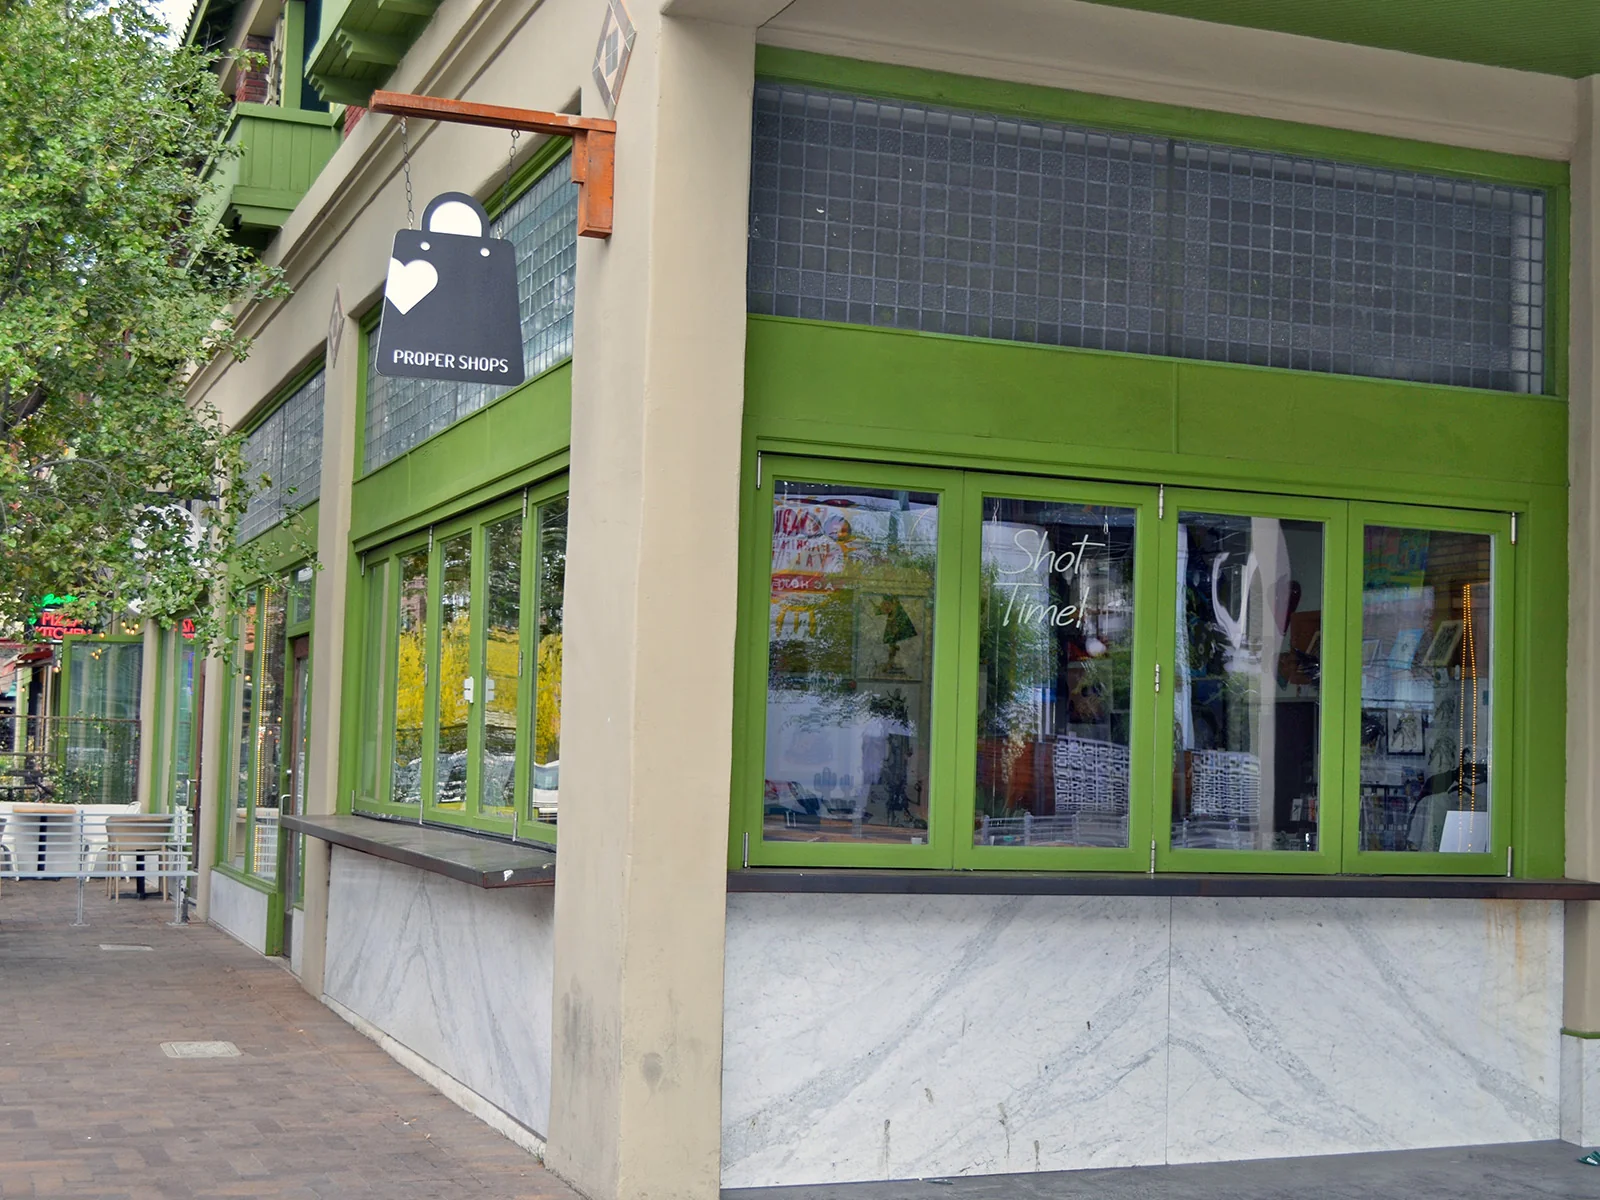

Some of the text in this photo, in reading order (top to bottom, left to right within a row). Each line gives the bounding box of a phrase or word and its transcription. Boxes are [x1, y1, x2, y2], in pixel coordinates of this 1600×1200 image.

[393, 349, 509, 373] PROPER SHOPS
[997, 528, 1106, 575] Shot
[993, 583, 1090, 629] Time!
